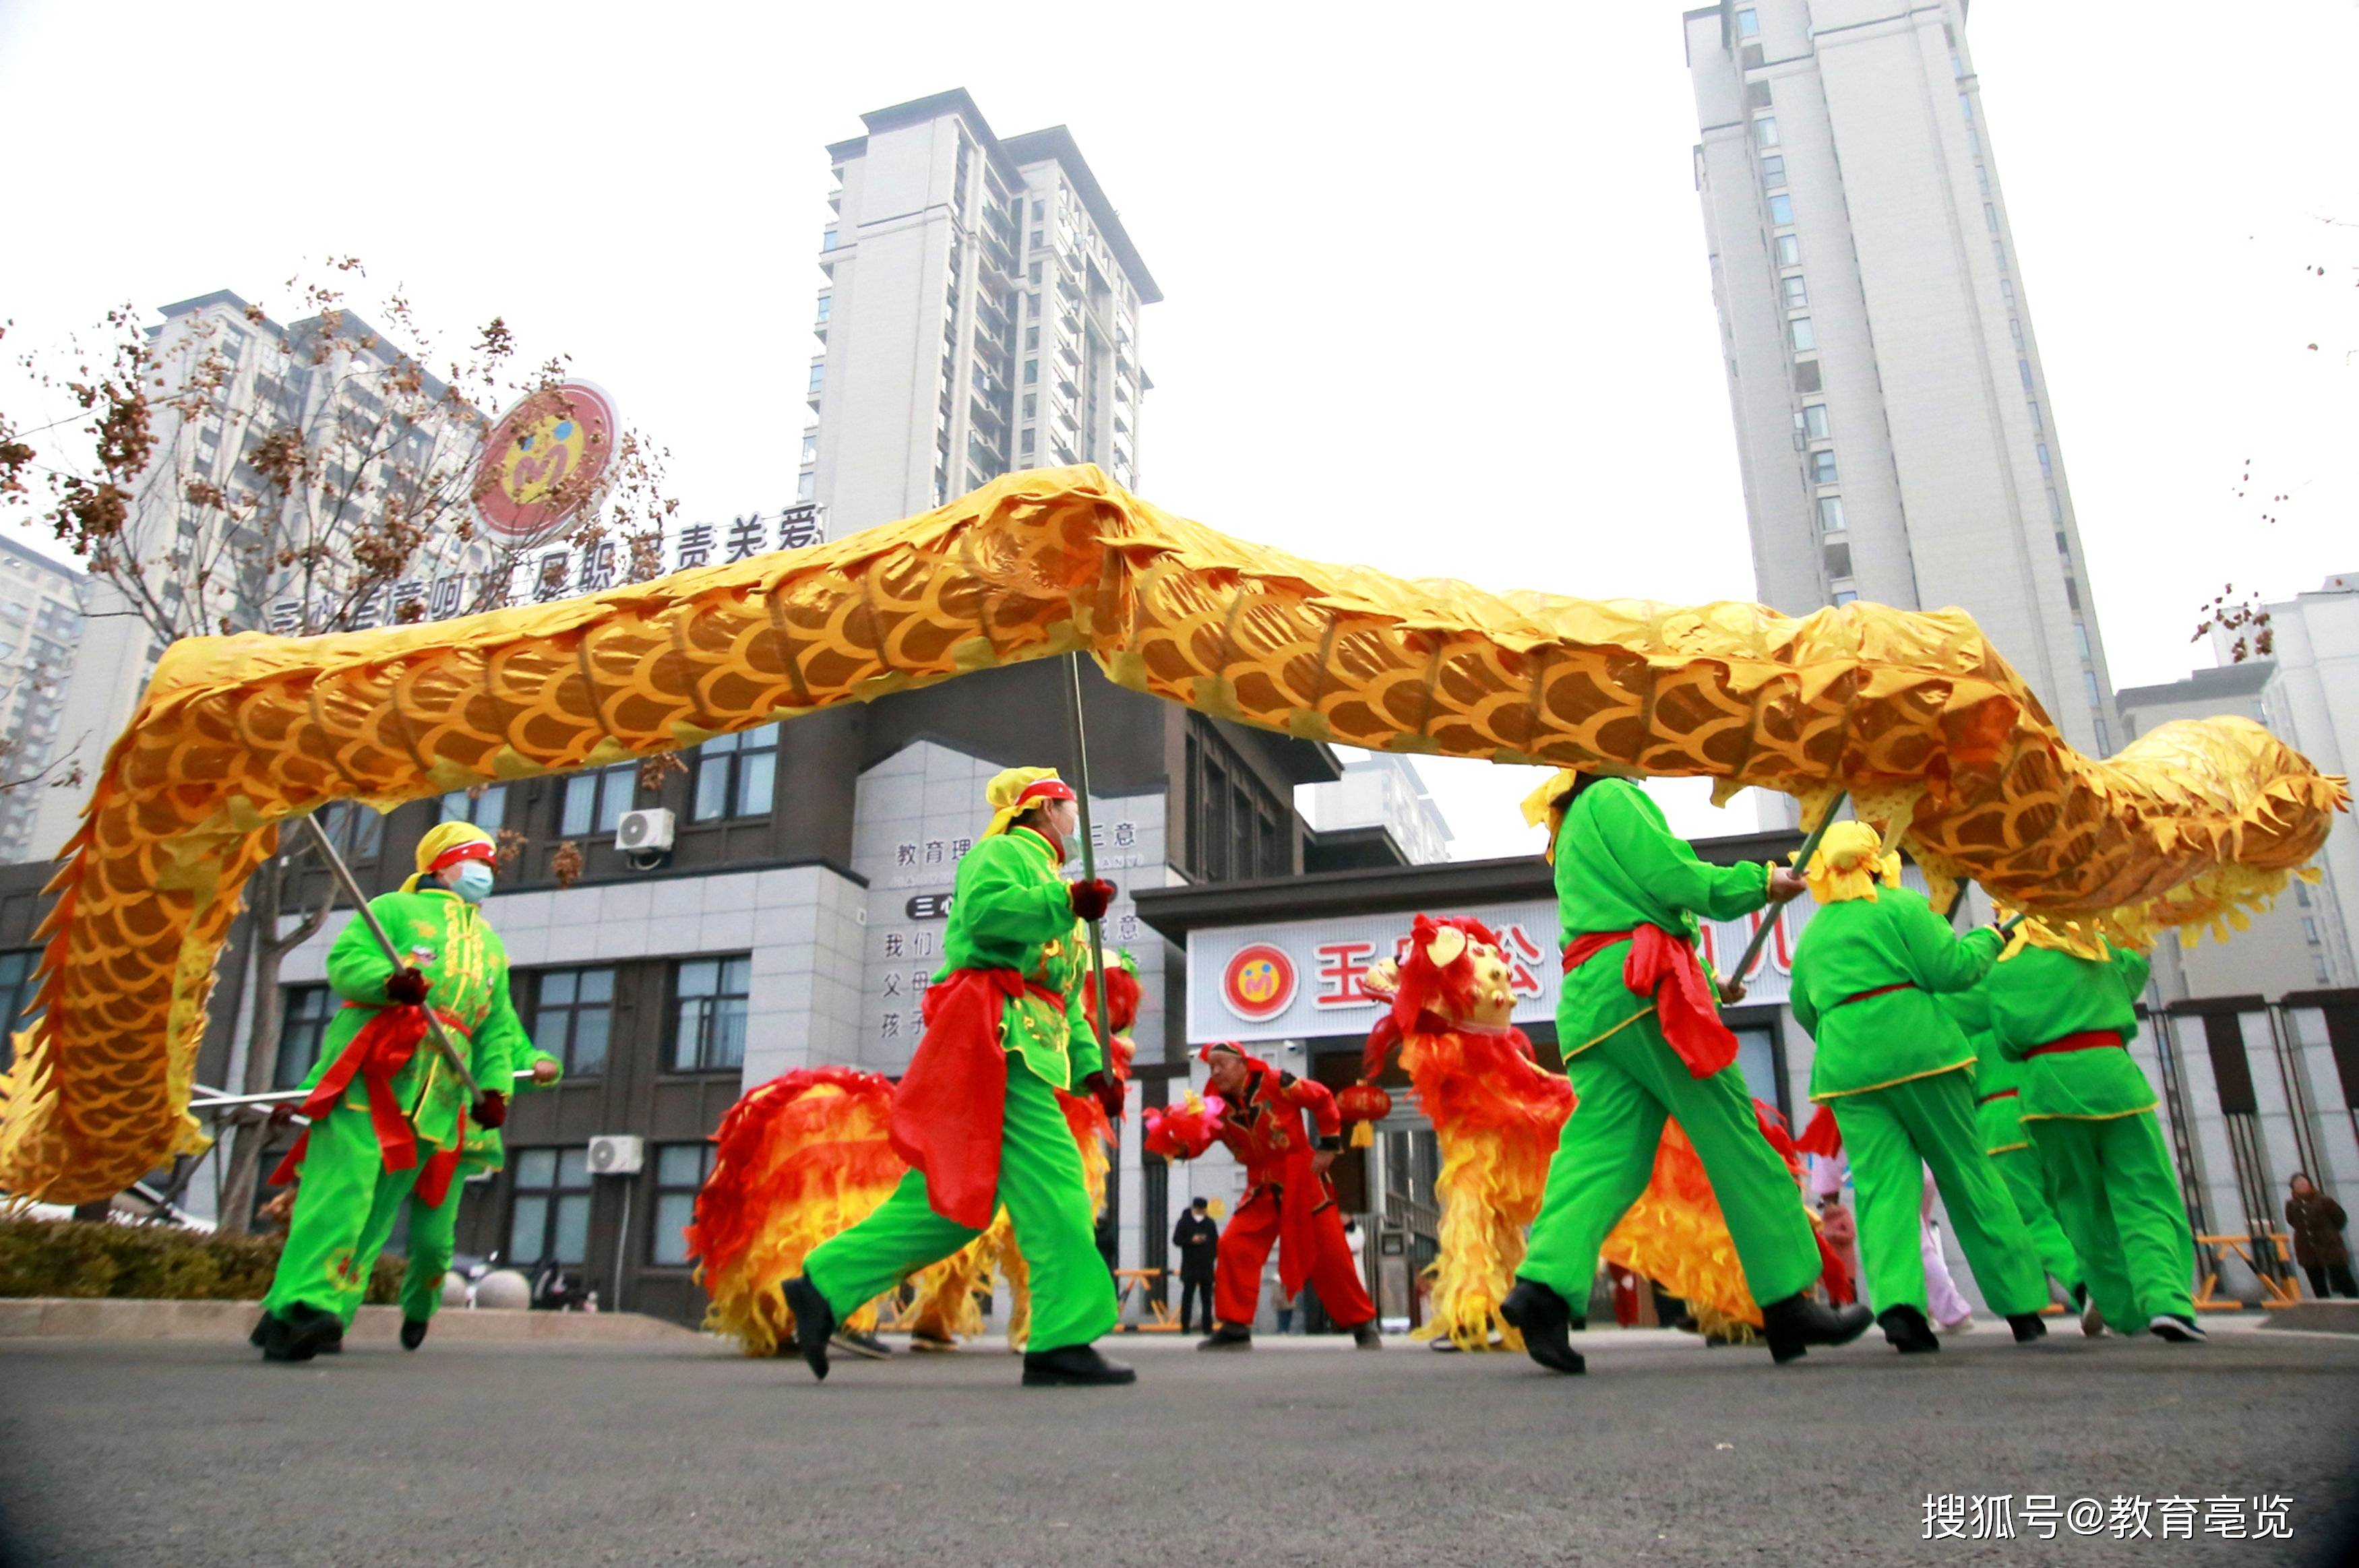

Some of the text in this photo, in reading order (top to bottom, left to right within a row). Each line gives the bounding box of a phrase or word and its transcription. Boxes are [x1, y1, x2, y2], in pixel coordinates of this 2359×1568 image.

[885, 933, 931, 958] 我们
[884, 971, 928, 998] 父母
[881, 1011, 923, 1038] 孩子
